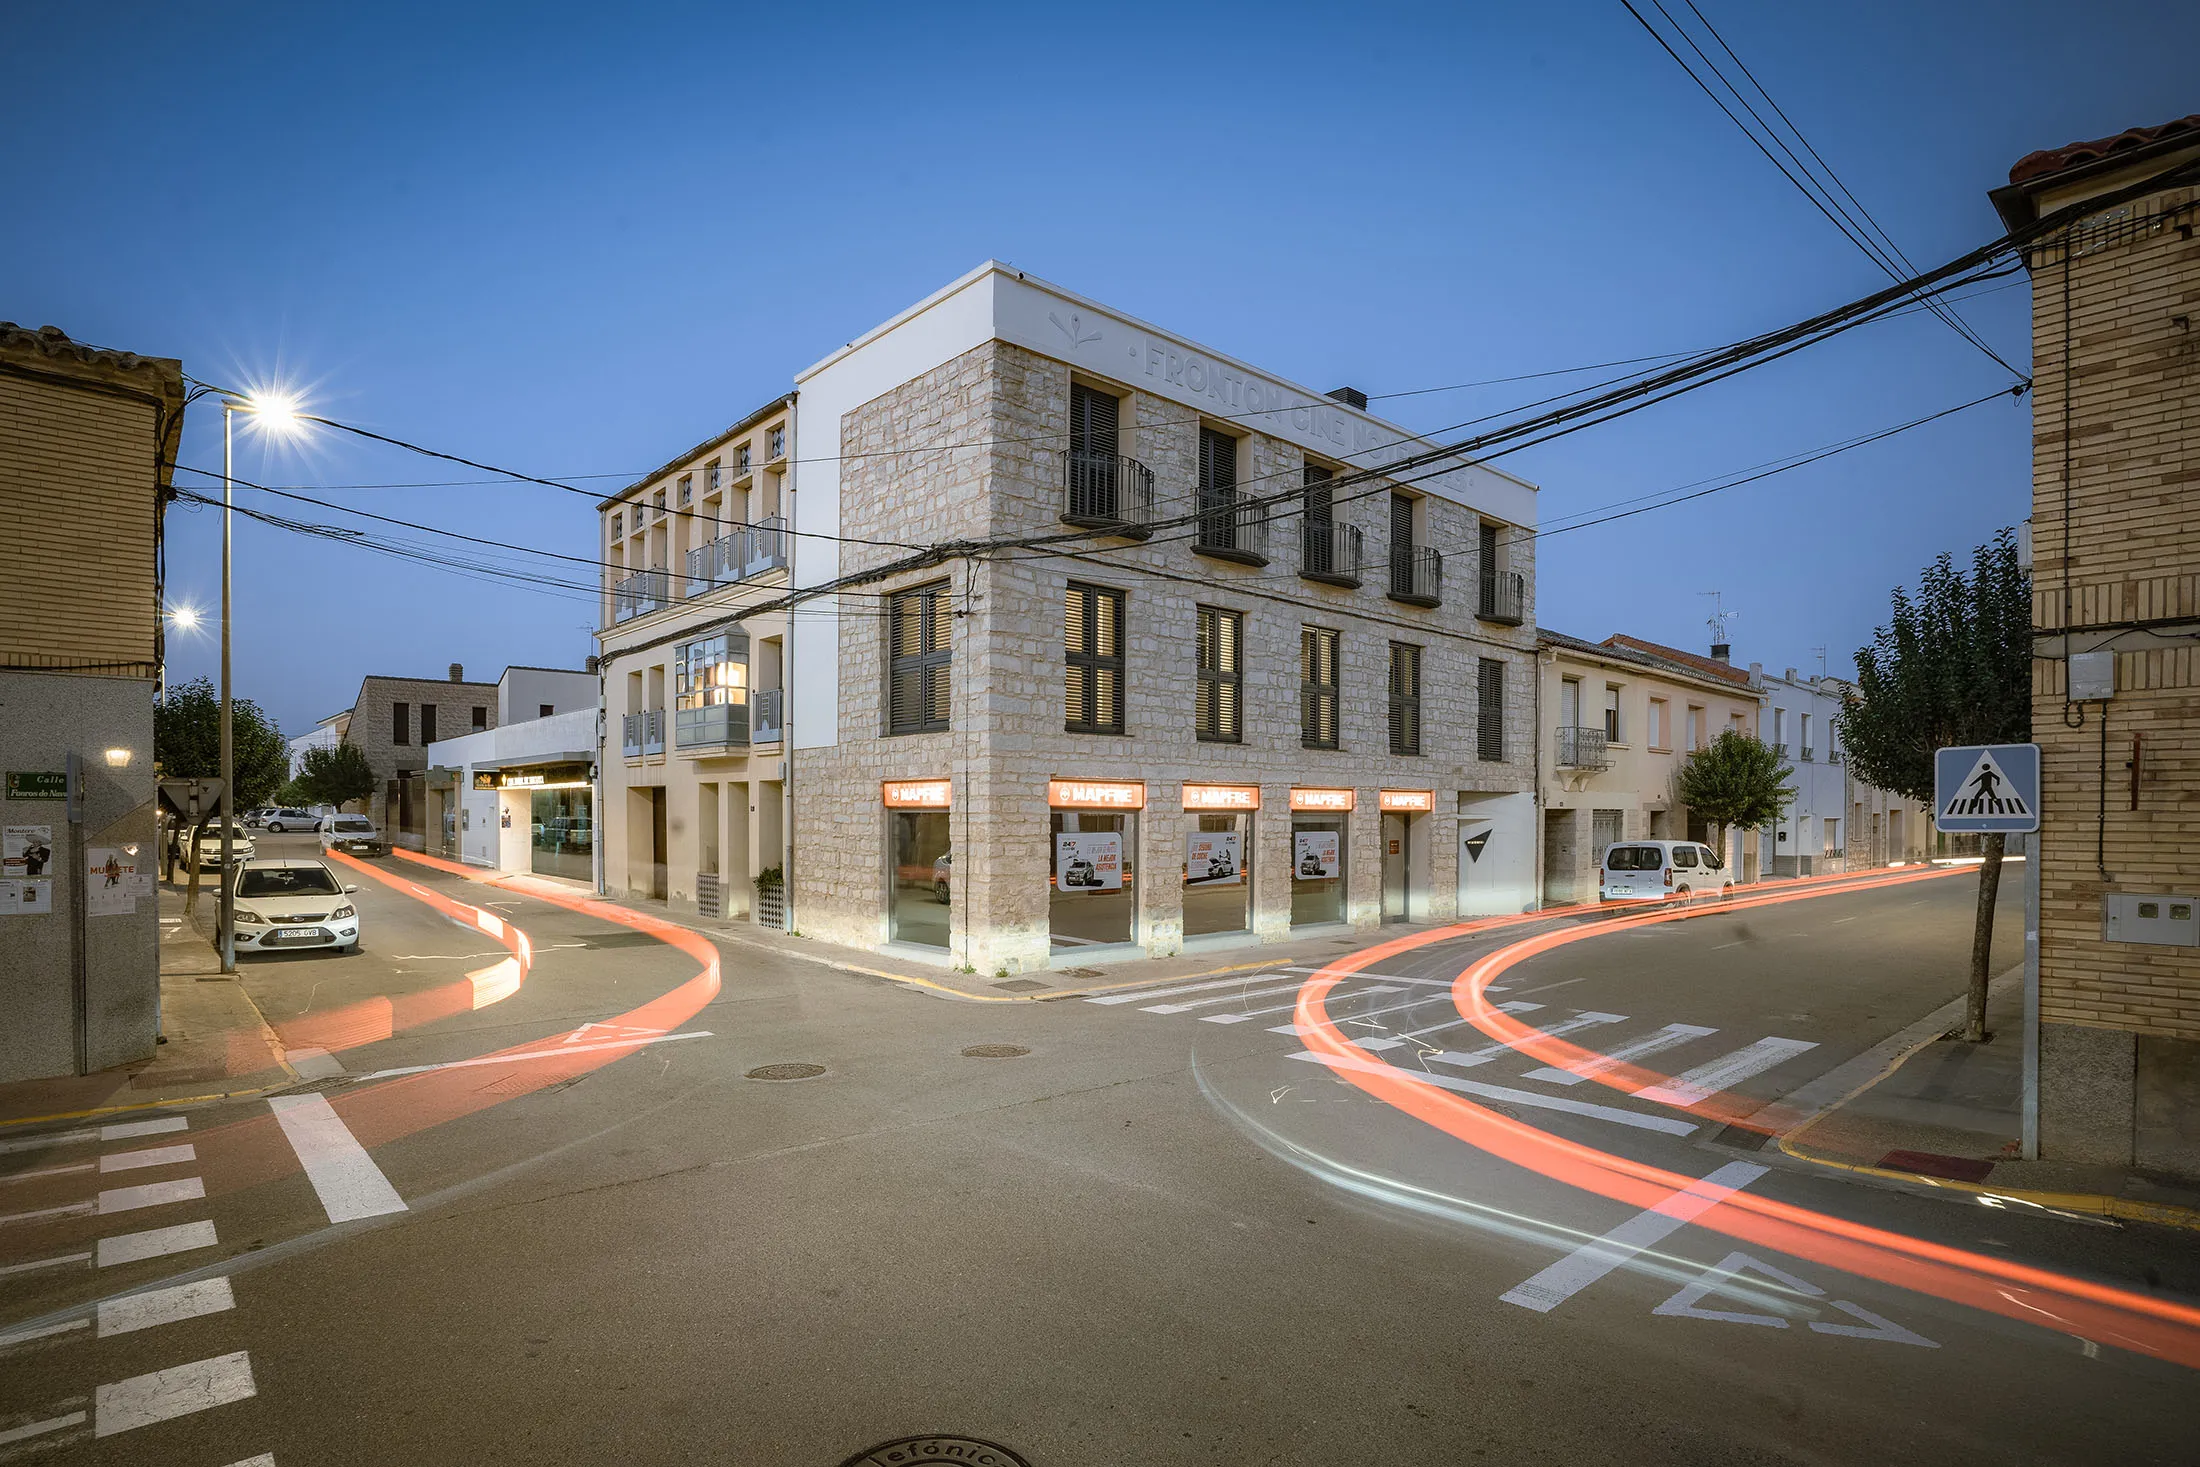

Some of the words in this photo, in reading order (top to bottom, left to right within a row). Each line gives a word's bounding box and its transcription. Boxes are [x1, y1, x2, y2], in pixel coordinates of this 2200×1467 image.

[1144, 336, 1283, 424] FRONTON
[1290, 396, 1346, 447] CINE
[37, 775, 65, 783] Calle
[900, 786, 945, 801] MAPFRE
[1072, 787, 1133, 803] MAPFRE
[1201, 791, 1251, 804] MAPFRE
[1304, 793, 1346, 806] MAPFRE
[1391, 795, 1425, 807] MAPFRE
[90, 865, 135, 875] MUETE
